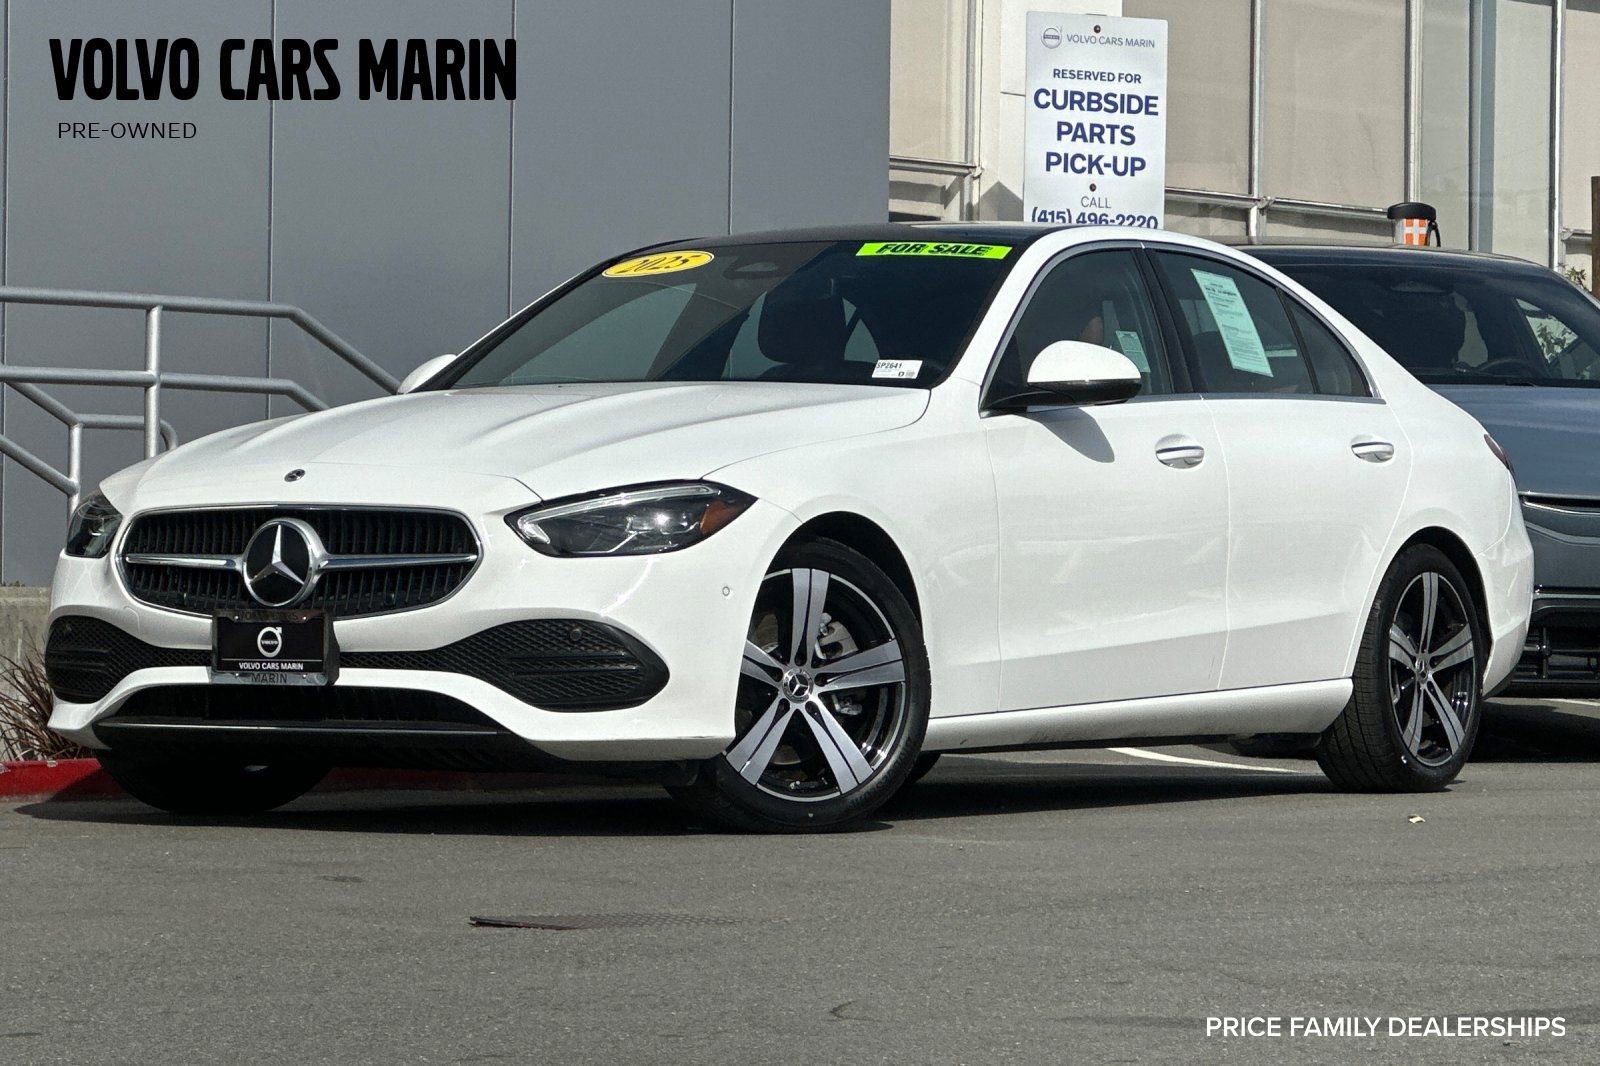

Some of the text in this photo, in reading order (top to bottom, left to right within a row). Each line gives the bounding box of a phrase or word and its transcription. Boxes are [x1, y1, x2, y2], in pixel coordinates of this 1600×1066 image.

[1066, 34, 1097, 45] VOLVO
[1098, 36, 1124, 47] CARS
[1125, 38, 1155, 48] MARIN
[1053, 68, 1142, 84] RESERVED FOR
[1033, 87, 1159, 116] CURBSIDE
[1056, 121, 1136, 146] PARTS
[1045, 151, 1147, 177] PICK-UP
[1080, 196, 1112, 208] CALL
[1031, 206, 1072, 224] (415)
[875, 243, 993, 256] FOR SALE
[616, 254, 704, 274] 2025
[239, 662, 304, 671] VOLVO CARS MARIN
[251, 673, 288, 684] MARIN
